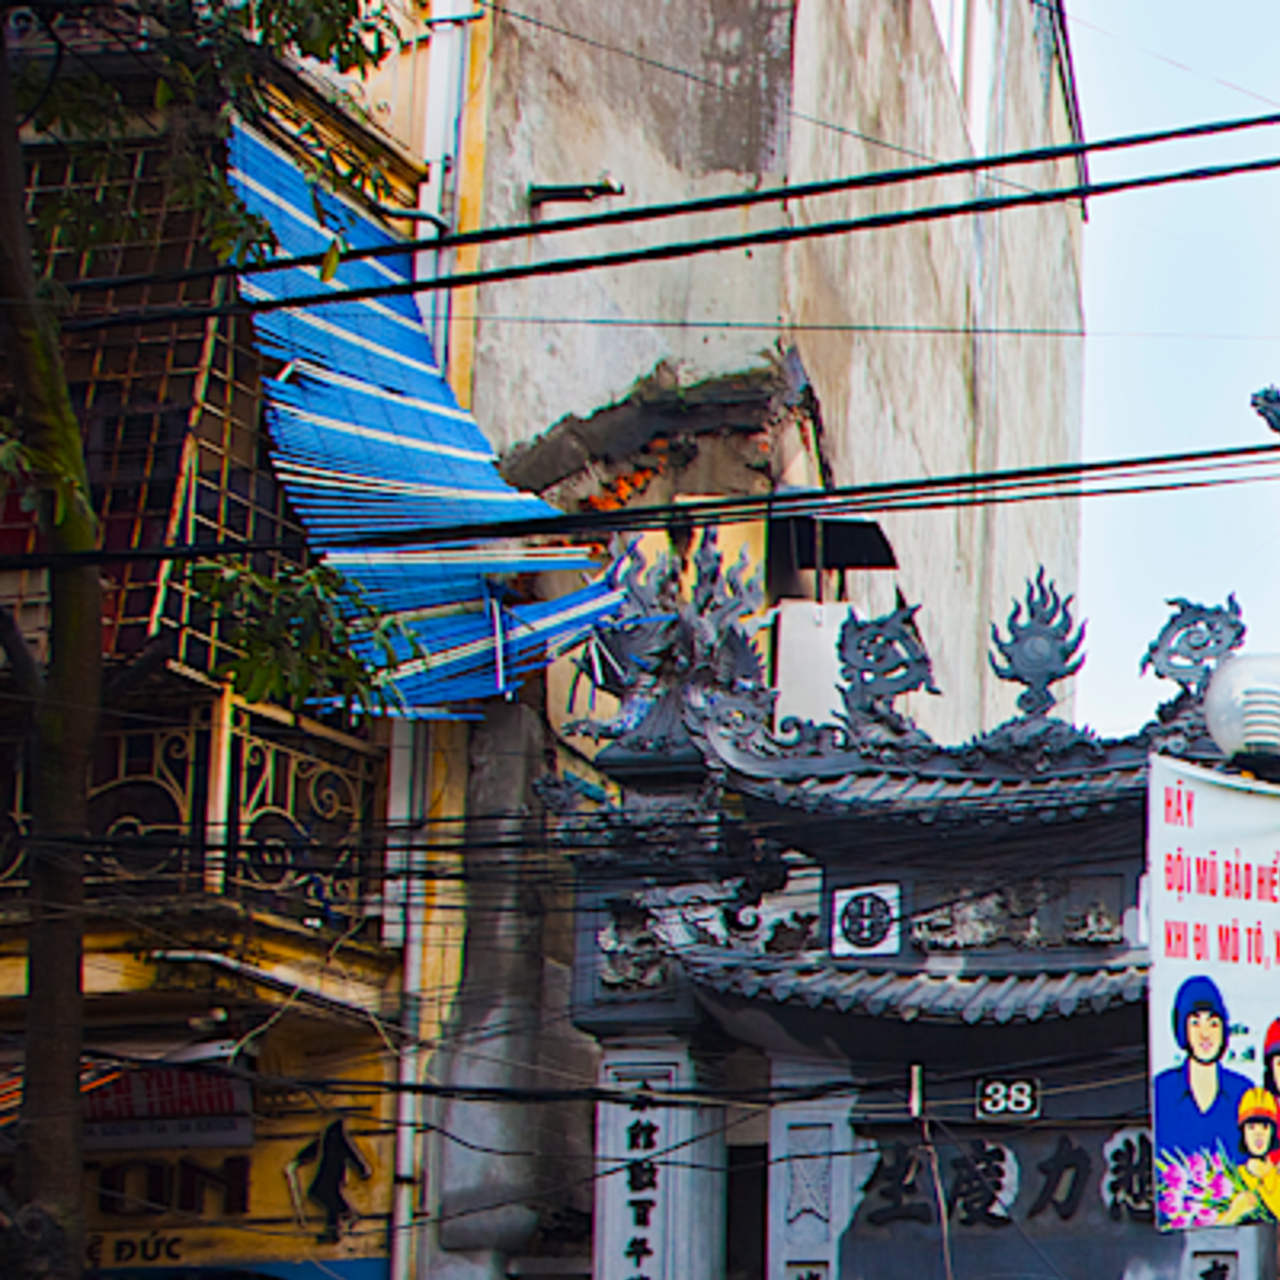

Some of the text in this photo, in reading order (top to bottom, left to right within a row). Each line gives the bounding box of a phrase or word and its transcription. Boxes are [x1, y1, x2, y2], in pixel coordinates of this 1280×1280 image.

[1164, 920, 1188, 958] KHI
[984, 1082, 1032, 1113] 38
[114, 1230, 183, 1261] ĐỨC
